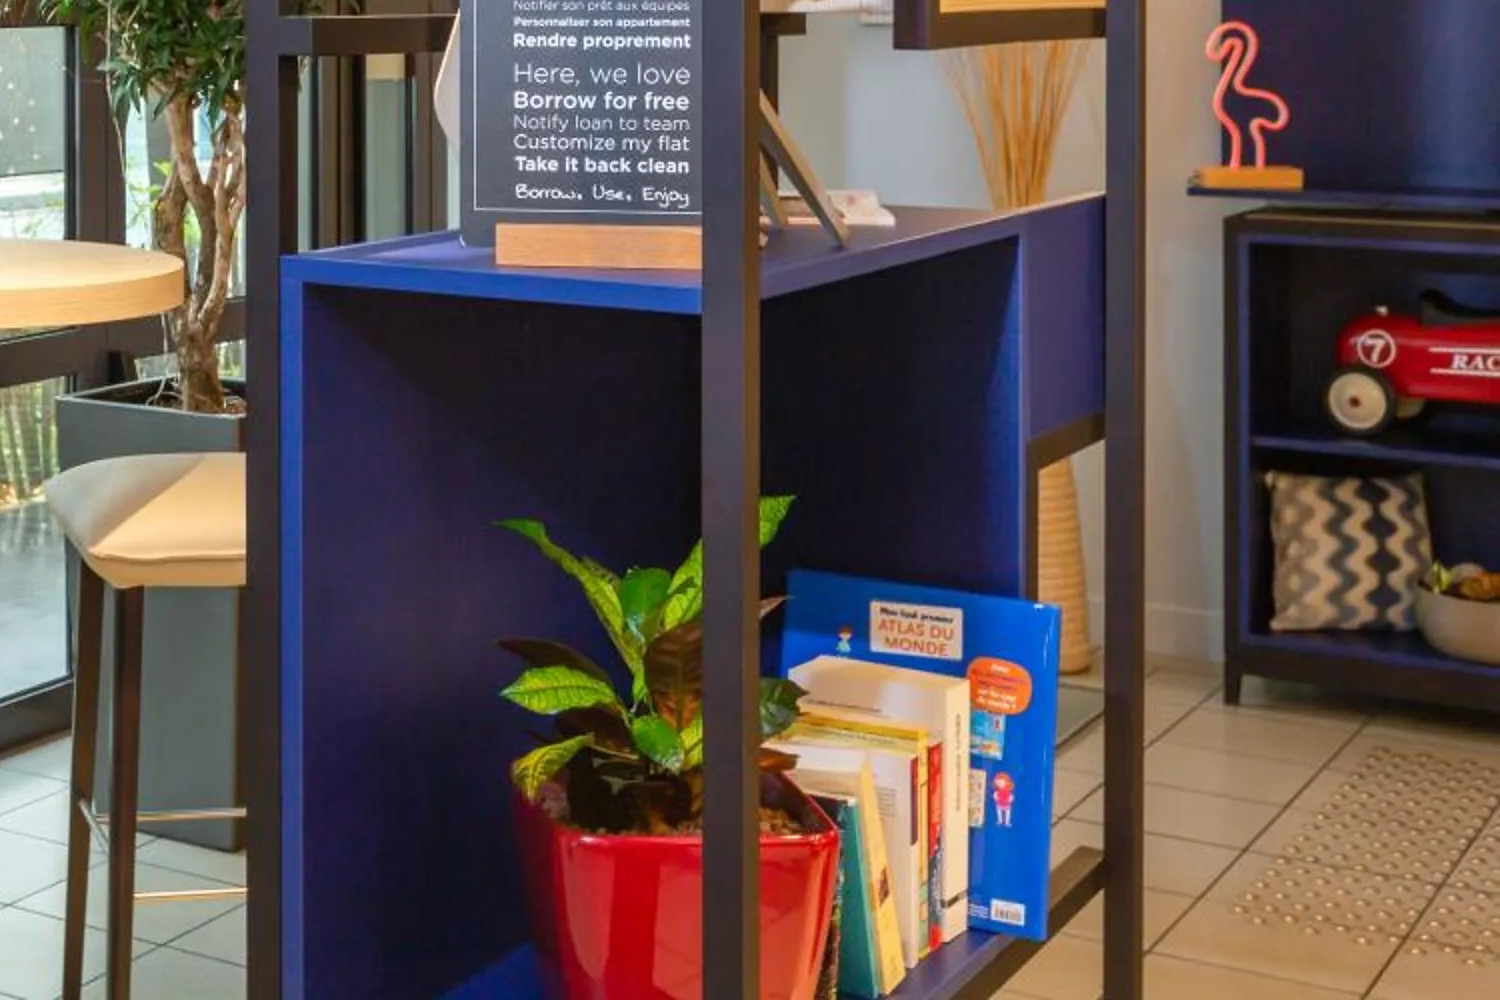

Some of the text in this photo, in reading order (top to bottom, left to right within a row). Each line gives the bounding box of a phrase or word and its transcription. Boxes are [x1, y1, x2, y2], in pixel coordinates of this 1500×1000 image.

[513, 0, 690, 12] Notifier son prêt aux équipes
[513, 16, 690, 28] Personnaliser son appartement
[513, 32, 691, 50] Rendre proprement
[514, 63, 691, 87] Here, we love
[514, 91, 690, 111] Borrow for free
[514, 114, 690, 133] Notify loan to team
[513, 134, 690, 153] Customize my flat
[515, 156, 690, 174] Take it back clean
[642, 185, 690, 209] Enjoy
[1363, 338, 1386, 363] 7
[878, 618, 955, 641] ATLAS DU
[884, 634, 949, 656] MONDE
